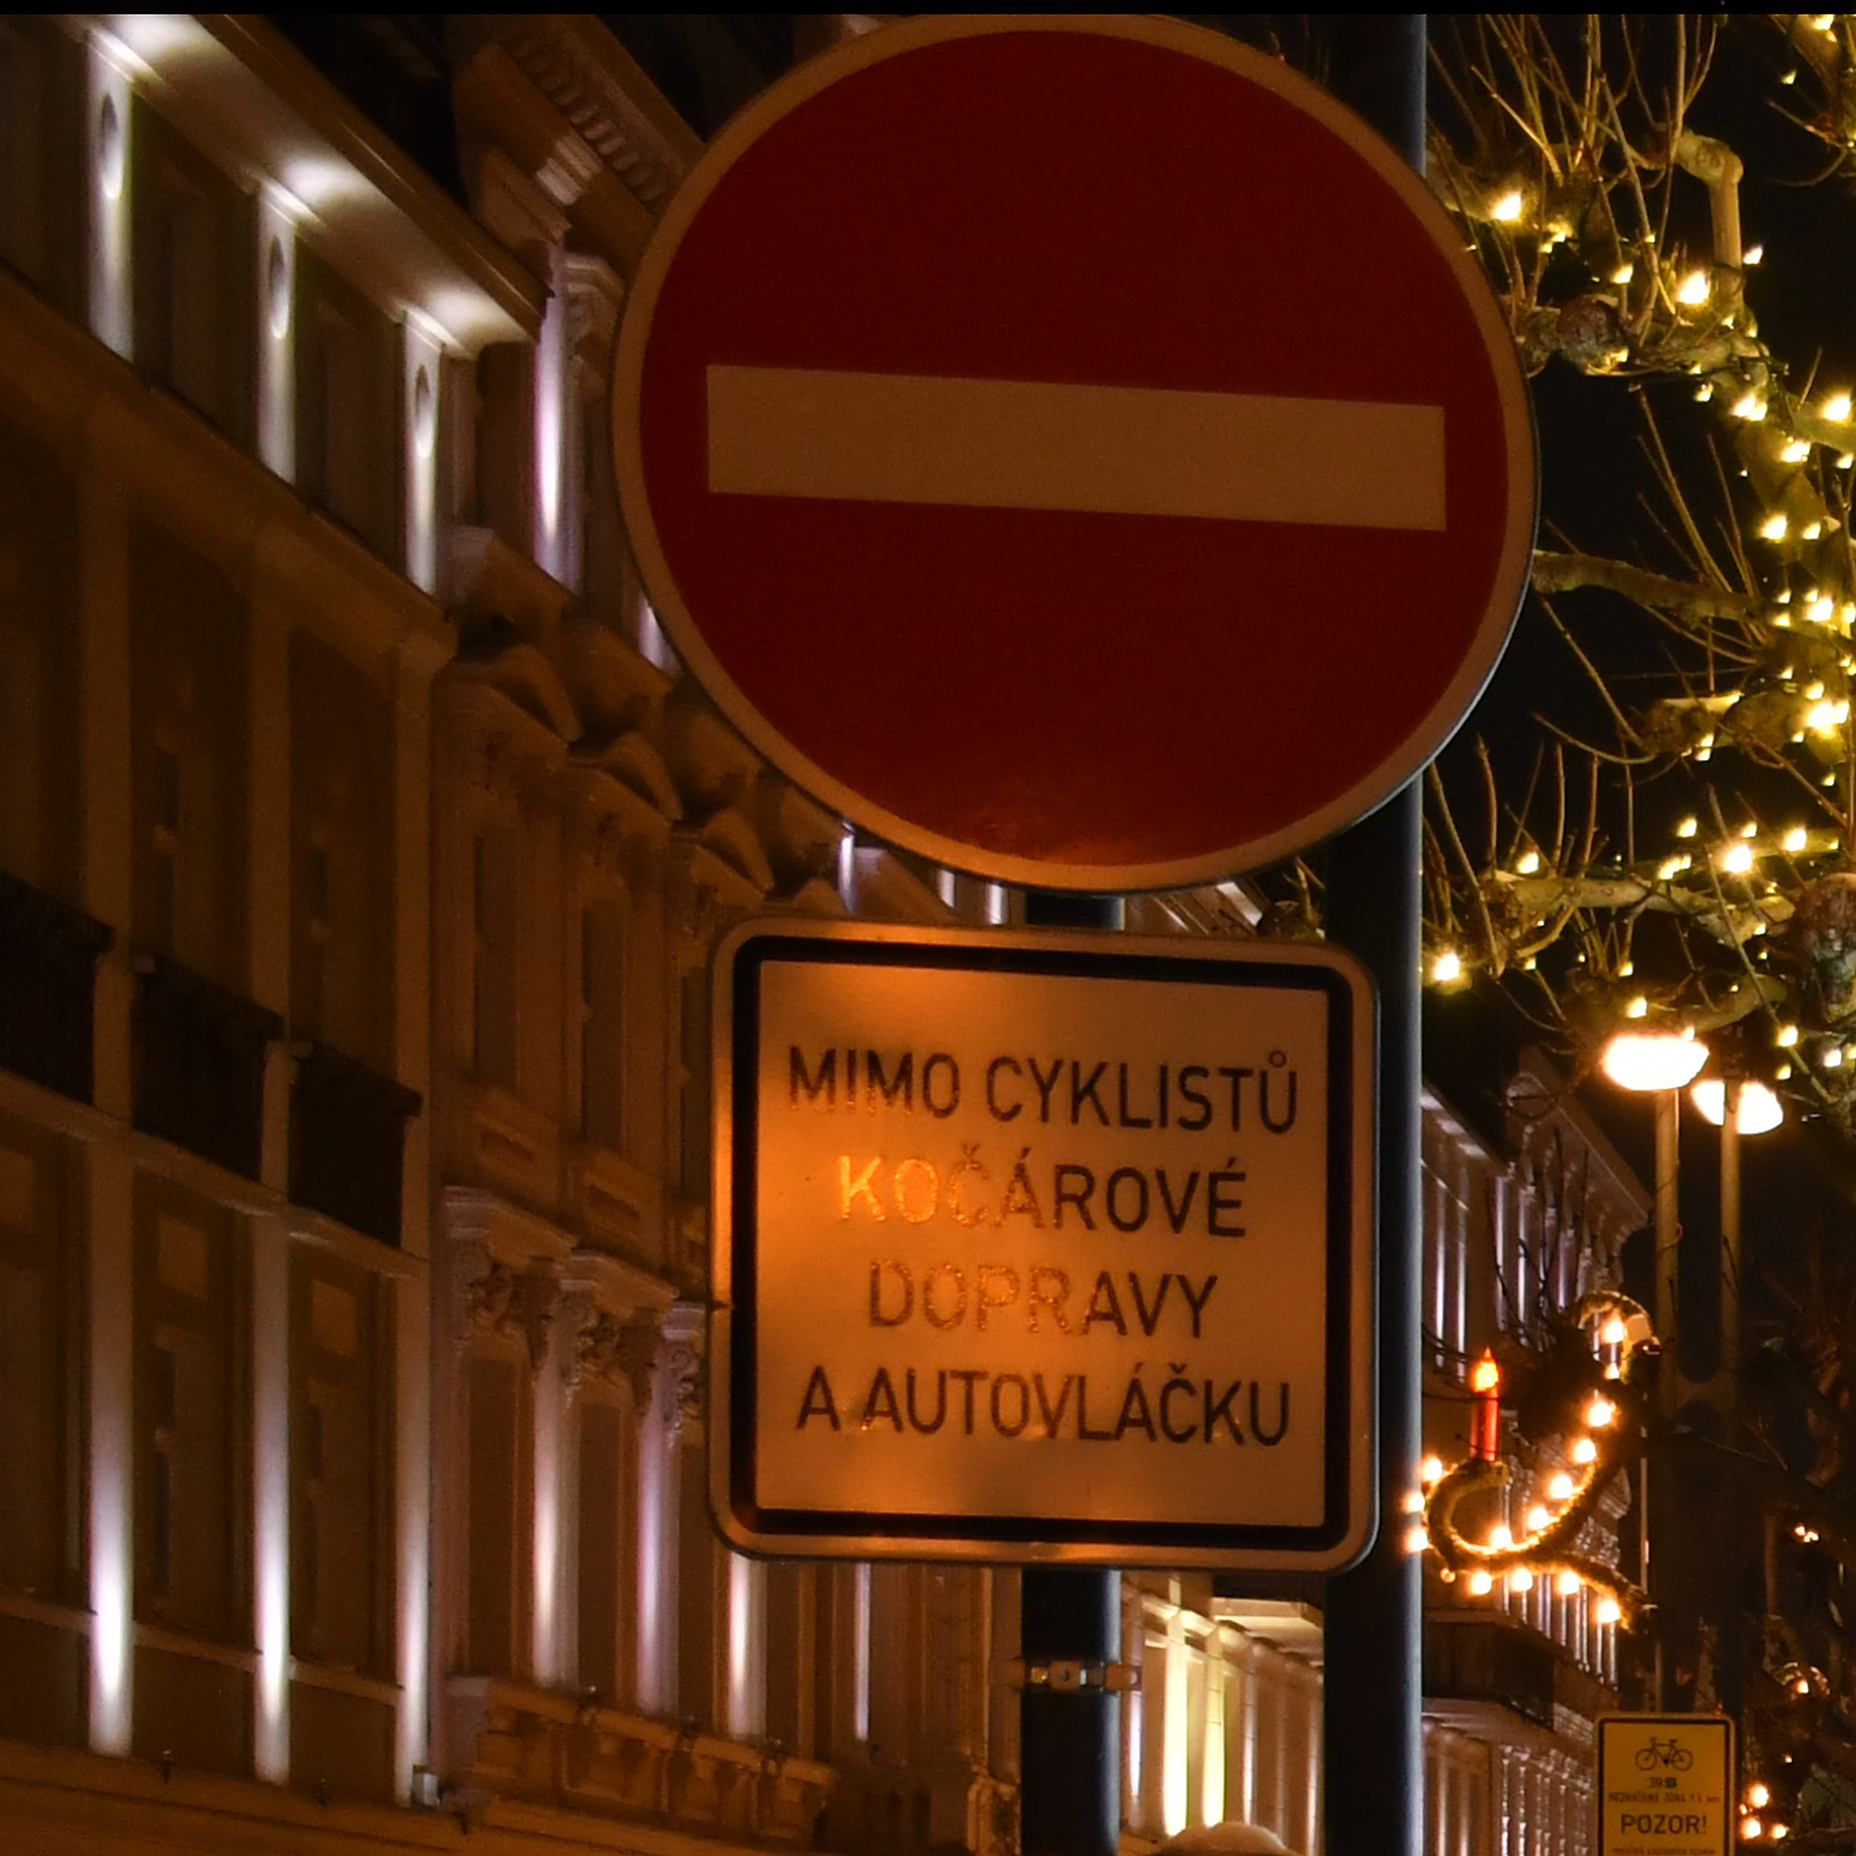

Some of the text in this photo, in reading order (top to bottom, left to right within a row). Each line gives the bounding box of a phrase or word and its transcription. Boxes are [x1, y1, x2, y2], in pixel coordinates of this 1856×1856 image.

[788, 1046, 1298, 1135] MIMO CYKLISTŮ
[836, 1142, 1247, 1238] KOČÁROVÉ
[868, 1260, 1218, 1339] DOPRAVY
[795, 1362, 1292, 1447] A AUTOVLÁČKU
[1620, 1813, 1708, 1835] POZOR!
